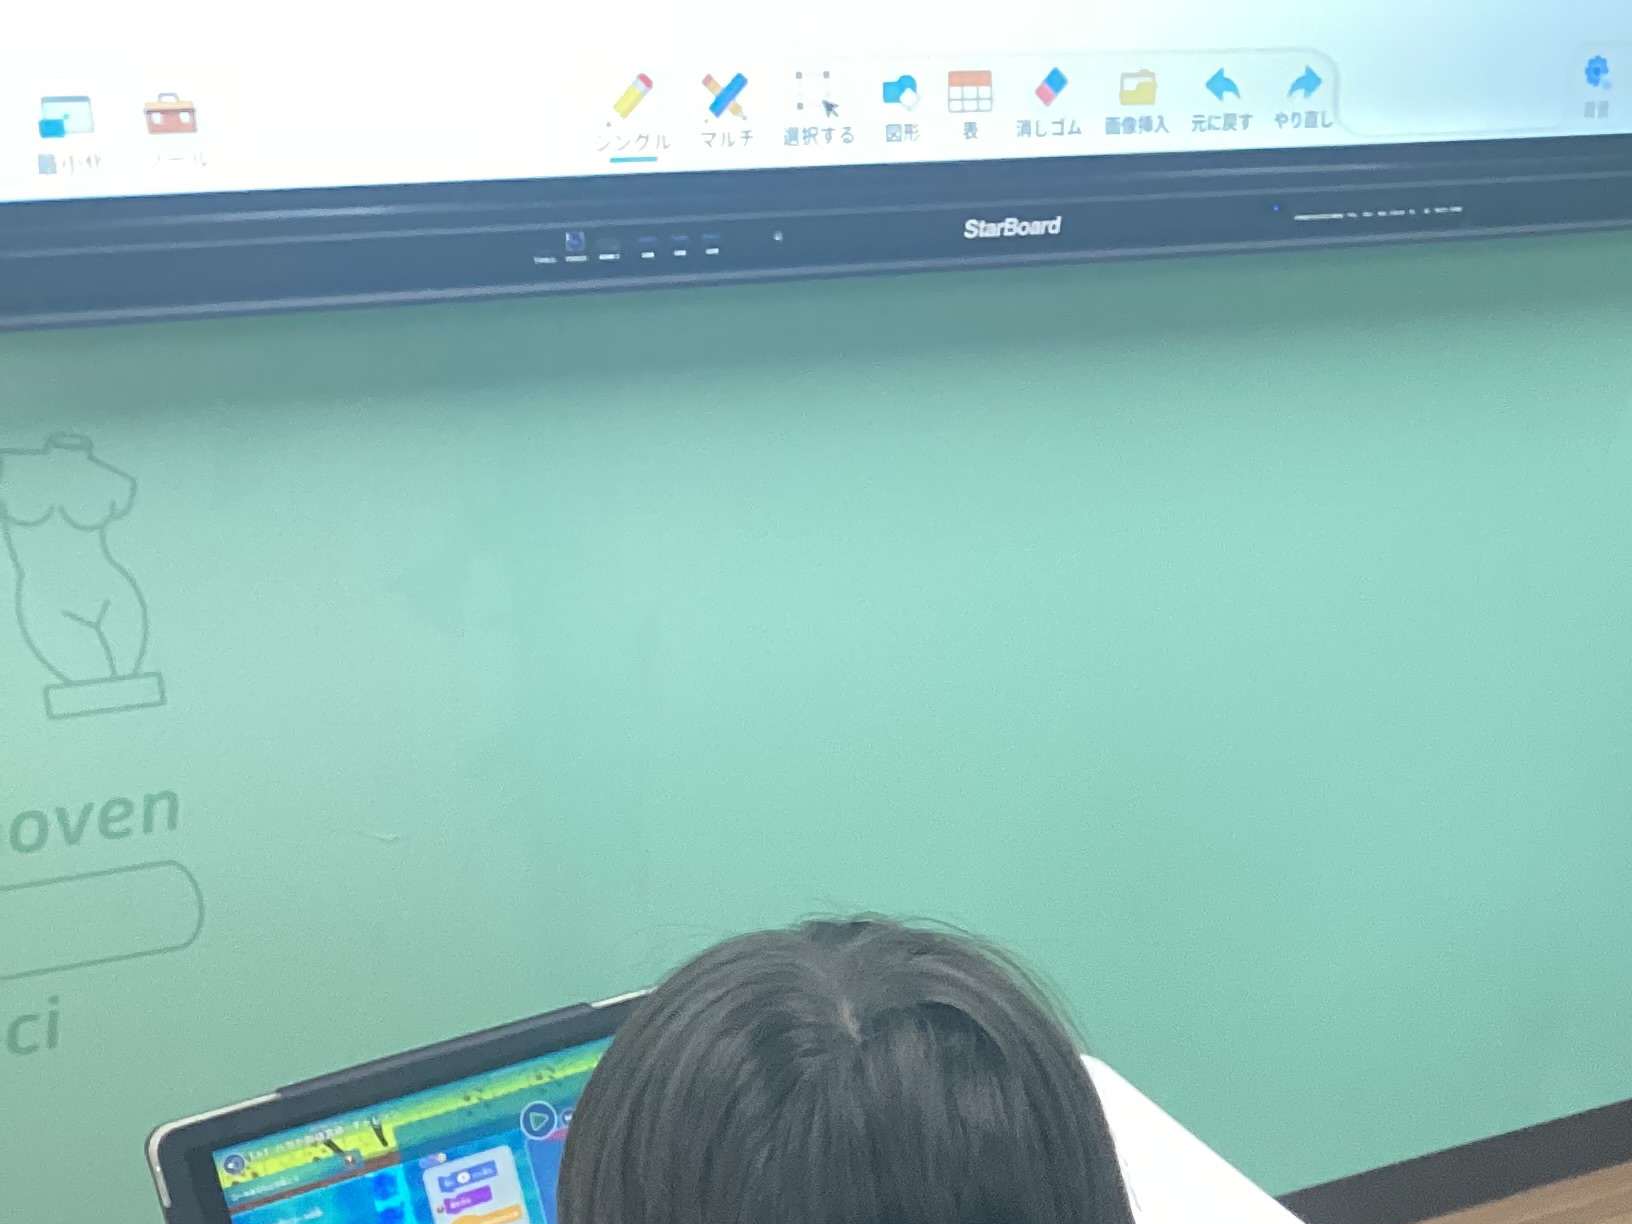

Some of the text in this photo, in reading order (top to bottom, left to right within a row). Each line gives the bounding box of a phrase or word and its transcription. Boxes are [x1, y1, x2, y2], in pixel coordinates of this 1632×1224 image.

[1016, 117, 1082, 138] 消しゴム
[1191, 112, 1254, 132] 元に戻す
[1274, 110, 1334, 130] やり直し
[701, 129, 754, 148] マルチ
[784, 126, 855, 147] 選択する
[885, 123, 920, 143] 図形
[963, 215, 1063, 239] StarBoard
[0, 790, 178, 854] oven
